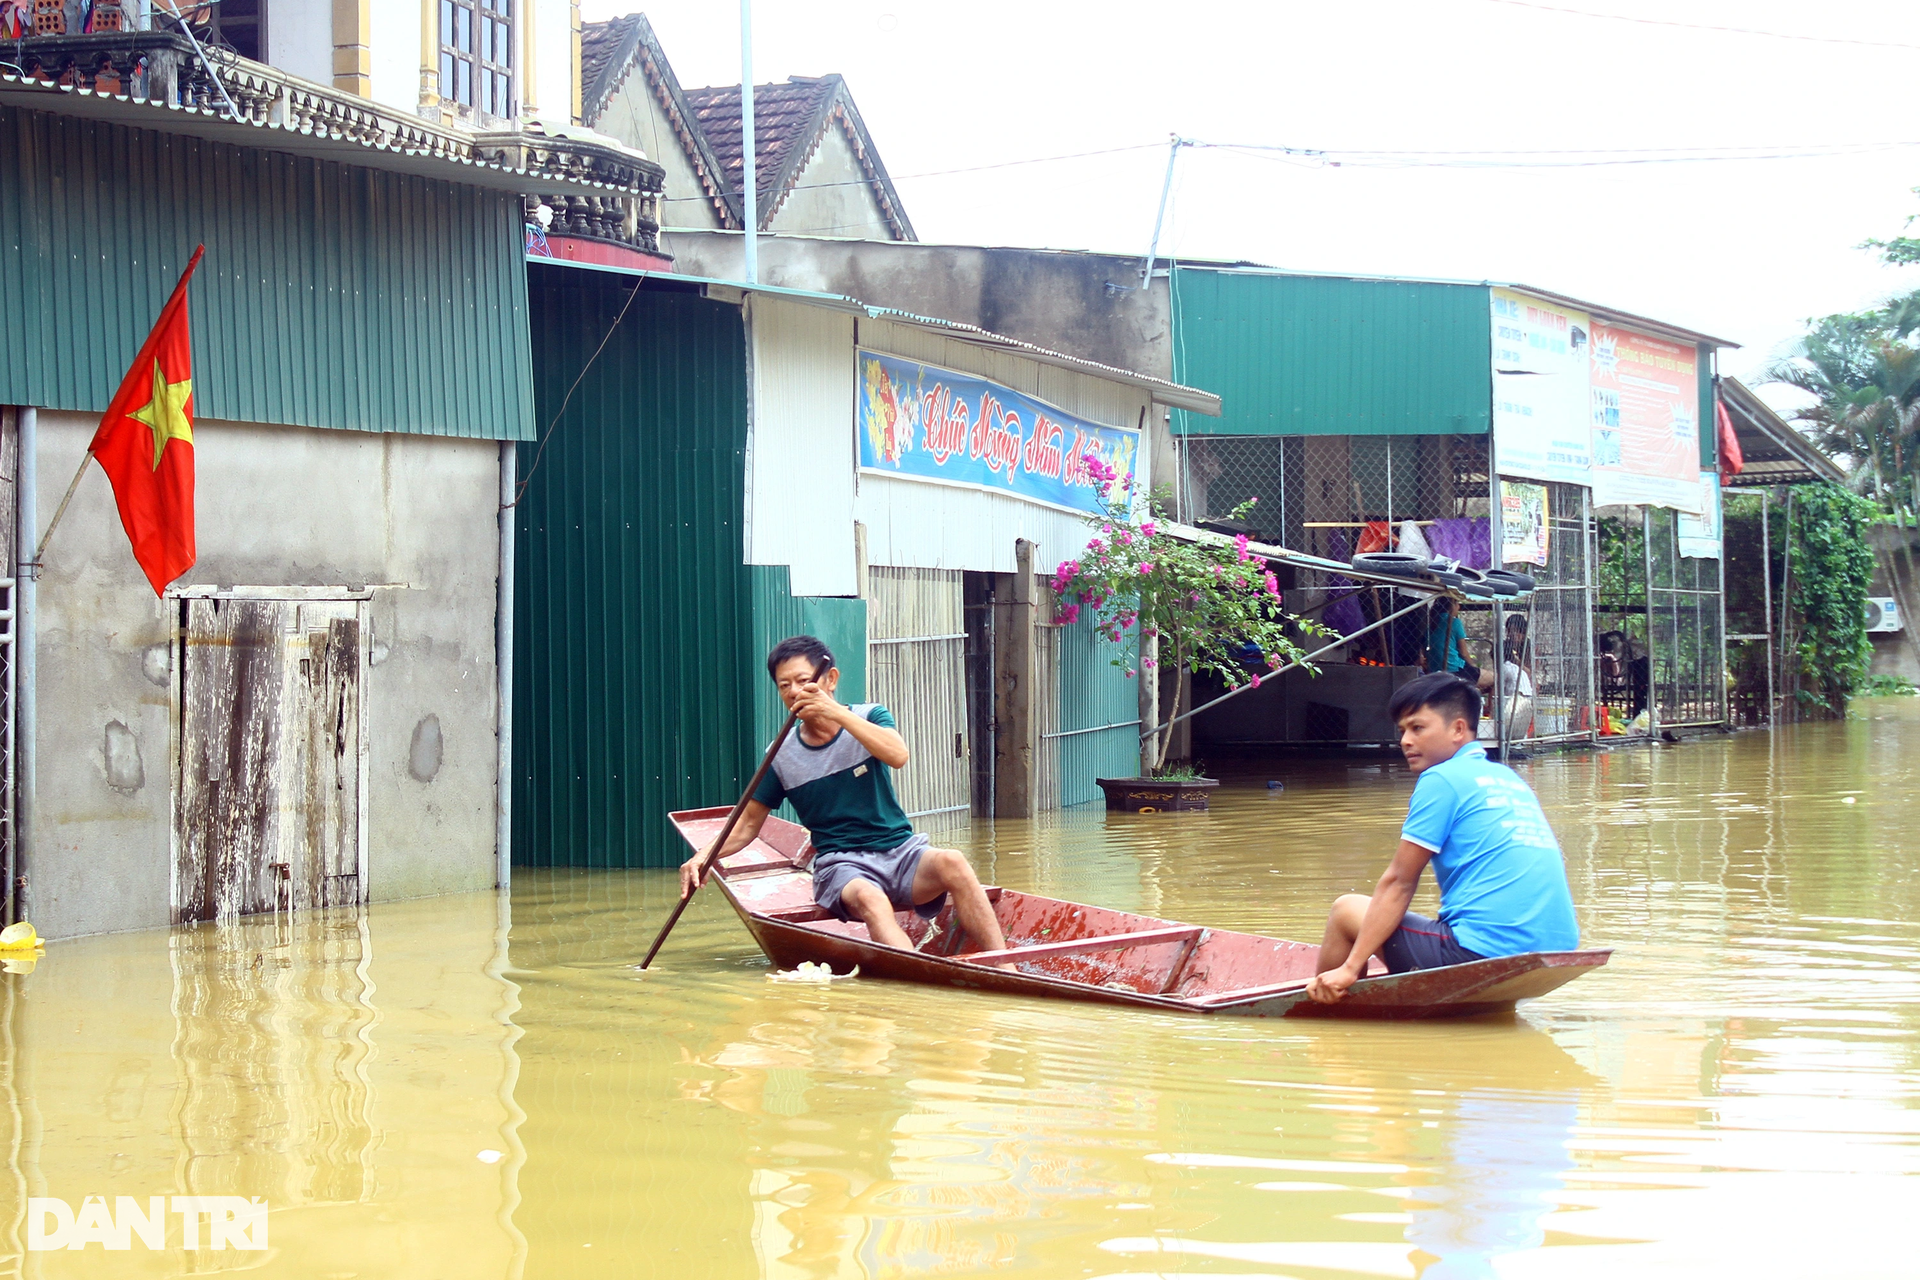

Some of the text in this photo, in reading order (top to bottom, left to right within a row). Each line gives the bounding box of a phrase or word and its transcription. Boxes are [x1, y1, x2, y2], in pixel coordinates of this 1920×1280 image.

[1616, 345, 1639, 363] THÔNG
[1640, 350, 1654, 366] BÁO
[922, 382, 969, 467] Chúc
[970, 391, 1022, 485] Mừng
[1023, 413, 1064, 479] Năm
[1063, 424, 1103, 488] Mớ
